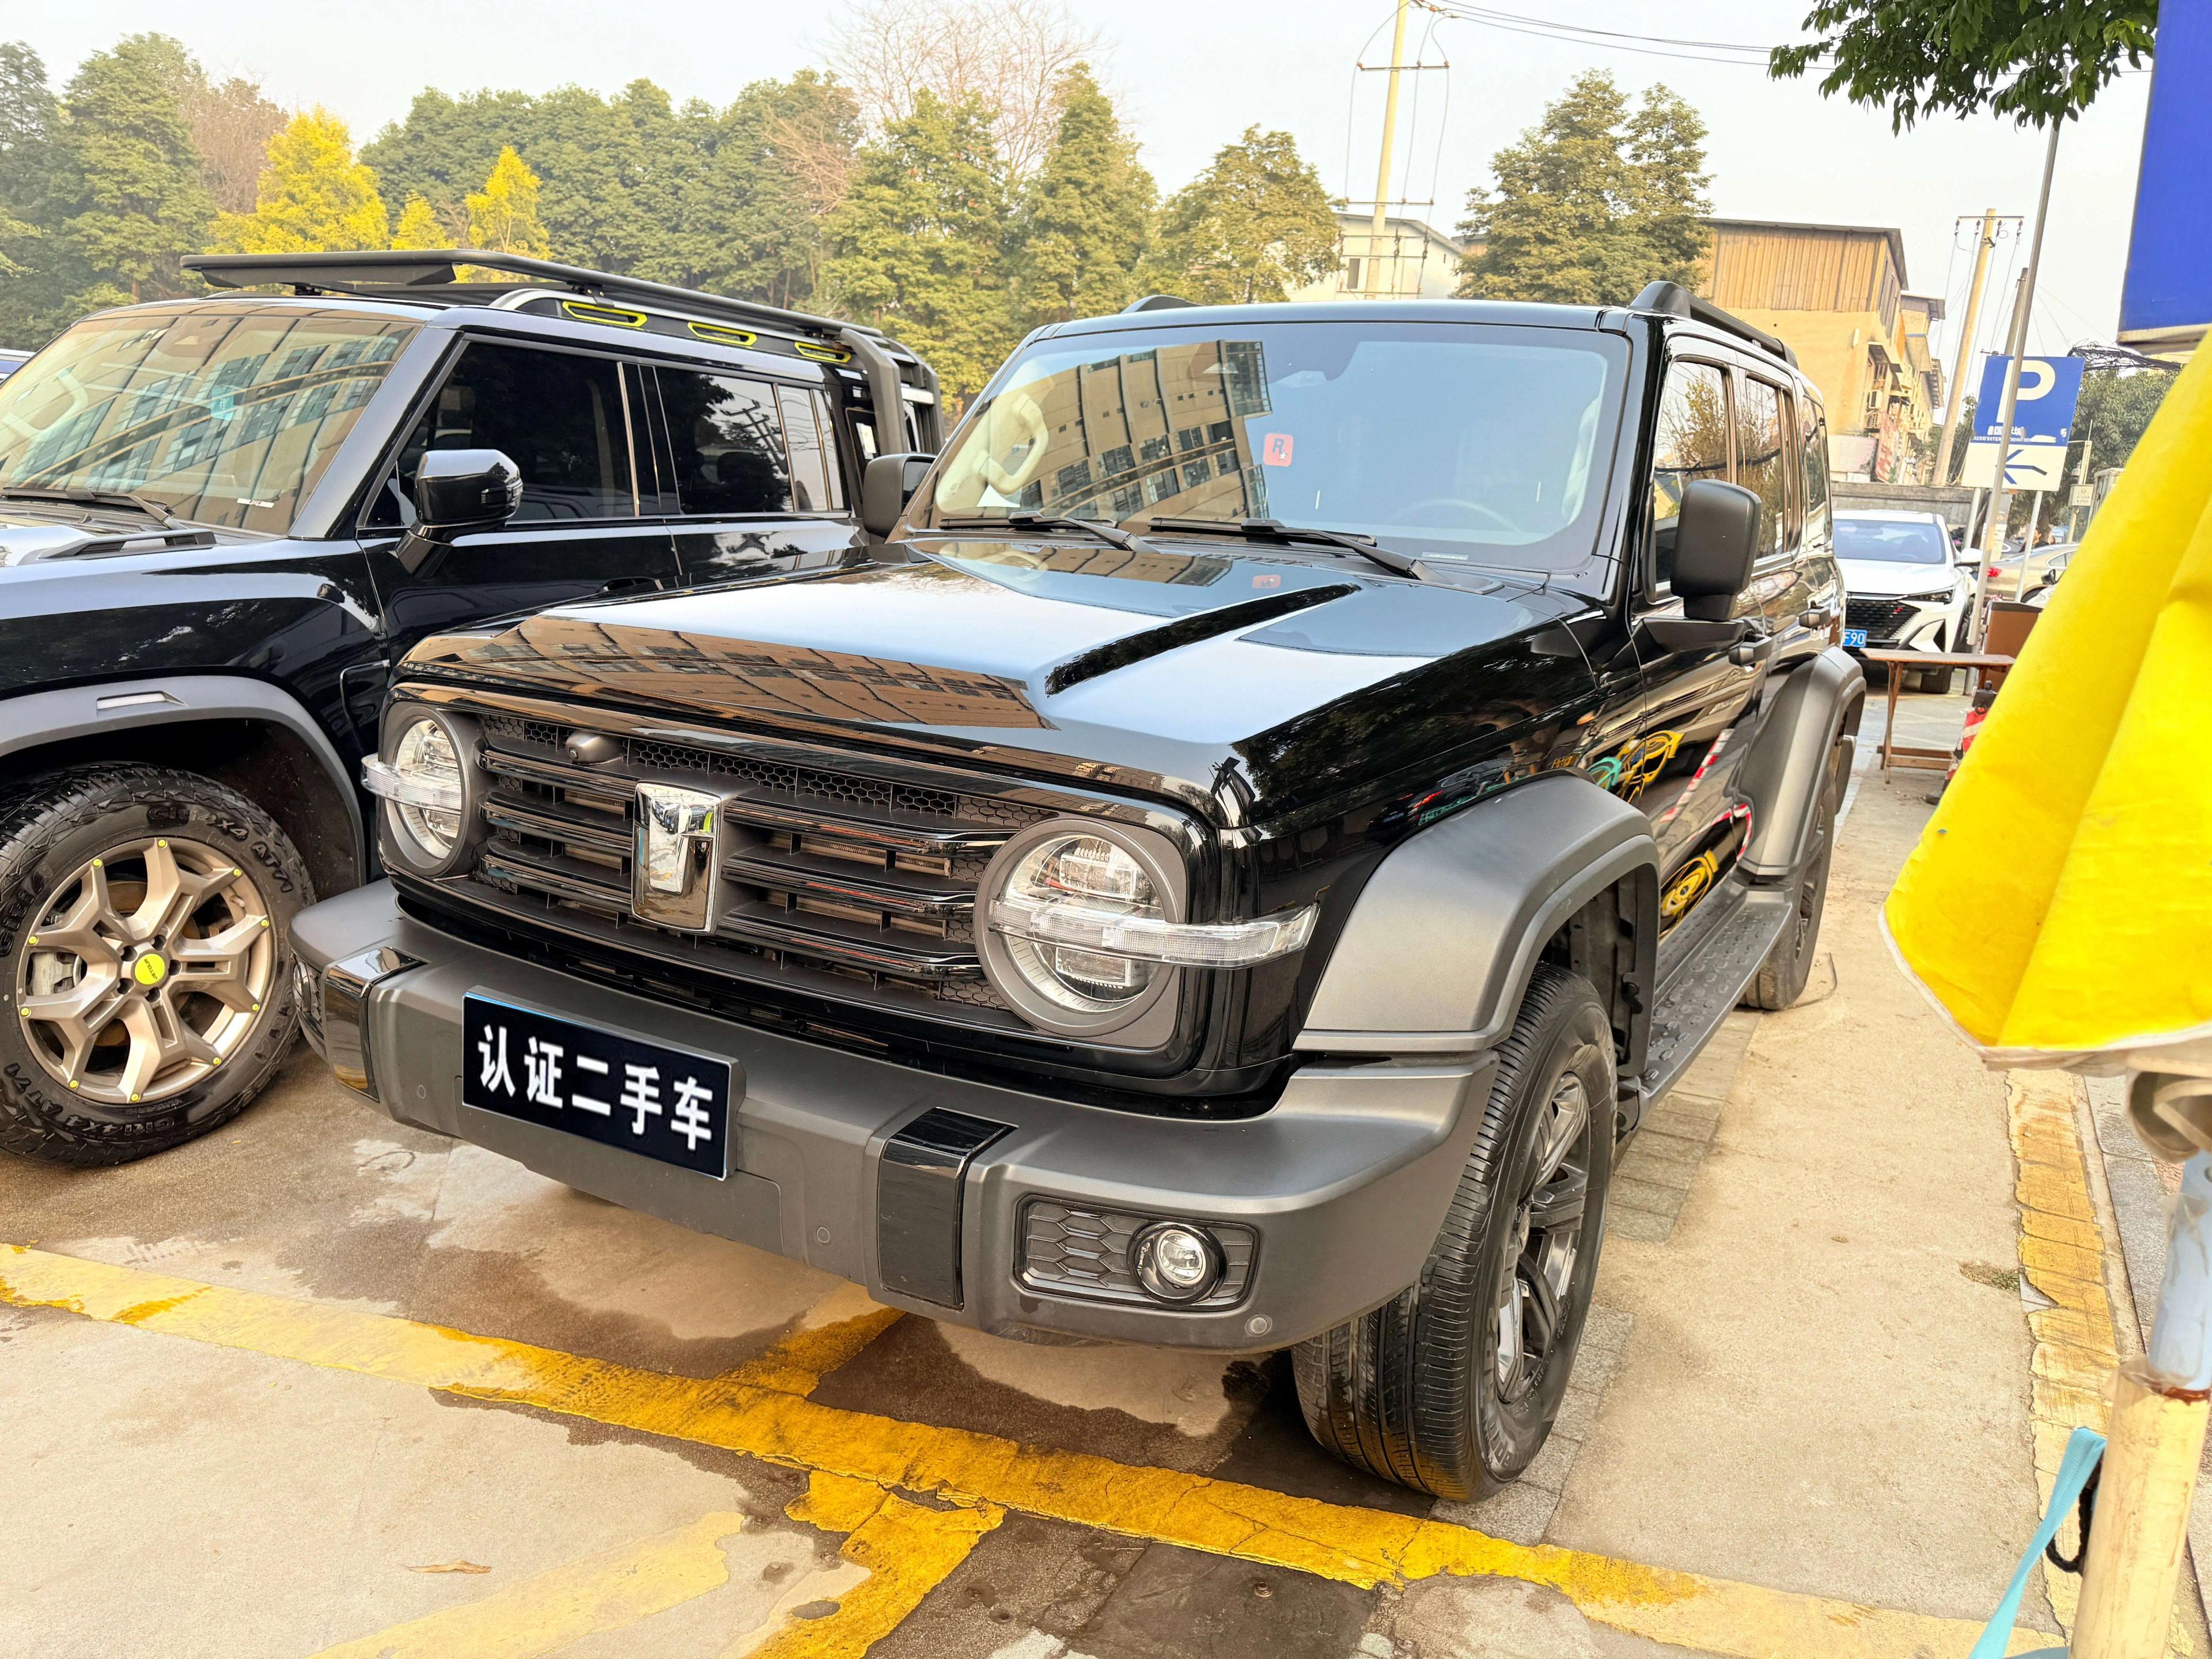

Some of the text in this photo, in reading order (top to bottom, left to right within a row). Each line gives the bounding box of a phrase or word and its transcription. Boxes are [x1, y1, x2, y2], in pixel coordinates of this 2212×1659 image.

[1996, 359, 2056, 424] P
[1272, 438, 1285, 454] R
[477, 1024, 714, 1151] 认证二手车
